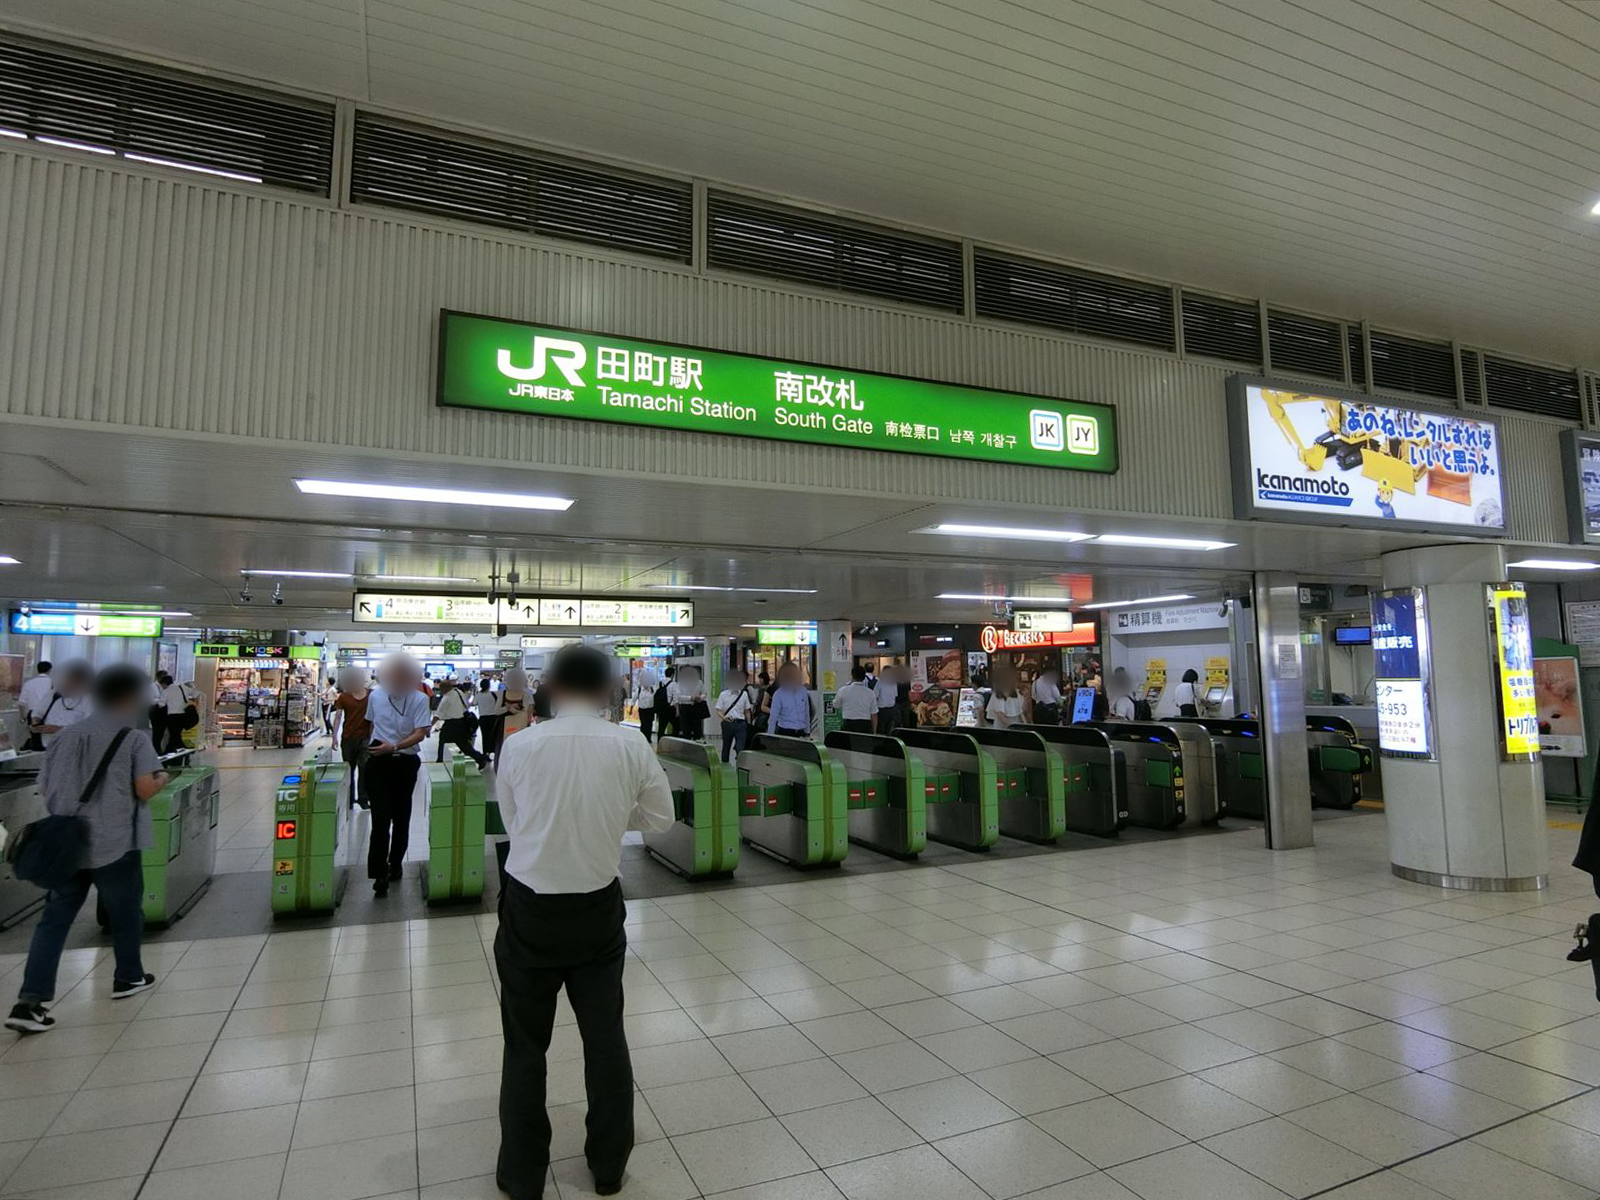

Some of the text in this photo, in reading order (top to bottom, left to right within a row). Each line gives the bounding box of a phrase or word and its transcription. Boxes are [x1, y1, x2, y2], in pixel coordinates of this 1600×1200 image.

[497, 335, 587, 387] JR
[596, 346, 703, 391] 田町駅
[509, 383, 575, 402] JR東日本
[774, 371, 864, 411] 南改札
[597, 385, 757, 421] Tamachi Station
[774, 407, 873, 435] South Gate
[1038, 422, 1055, 438] JK
[1347, 408, 1492, 450] あのね、レンタルすれば
[885, 420, 940, 441] 南检票口
[1075, 426, 1091, 442] JY
[949, 430, 1017, 450] 남쪽 개찰구
[1410, 446, 1496, 477] いいと思うよ。
[1256, 467, 1350, 496] kanamoto
[386, 598, 394, 608] 4
[446, 600, 453, 610] 3
[615, 603, 622, 614] 2
[665, 604, 670, 614] 1
[15, 615, 28, 629] 4
[143, 619, 156, 635] 3
[1130, 612, 1163, 627] 精算機
[246, 646, 282, 654] KIOSK
[277, 822, 296, 839] IC
